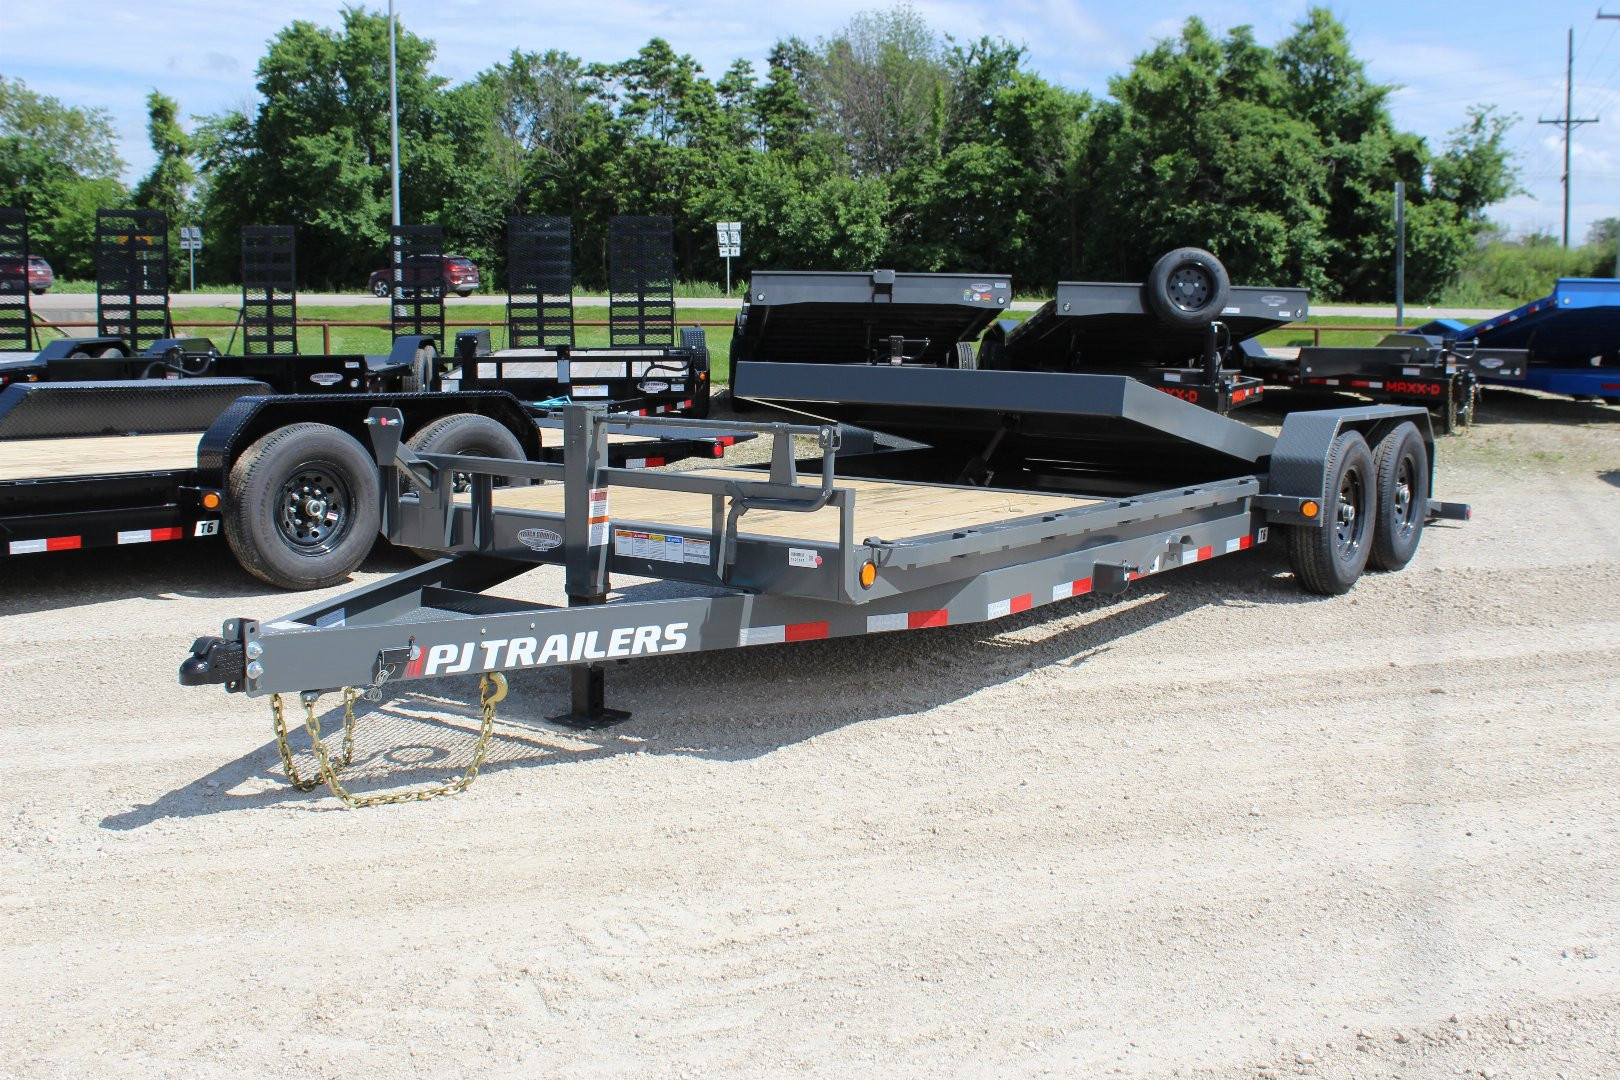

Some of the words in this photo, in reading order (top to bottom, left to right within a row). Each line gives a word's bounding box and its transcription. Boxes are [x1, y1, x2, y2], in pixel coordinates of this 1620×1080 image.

[720, 233, 726, 242] 5
[731, 233, 739, 242] 52
[1386, 381, 1440, 395] MAXX-D
[200, 522, 214, 534] T6
[425, 642, 475, 676] PJ
[480, 622, 689, 670] TRAILERS
